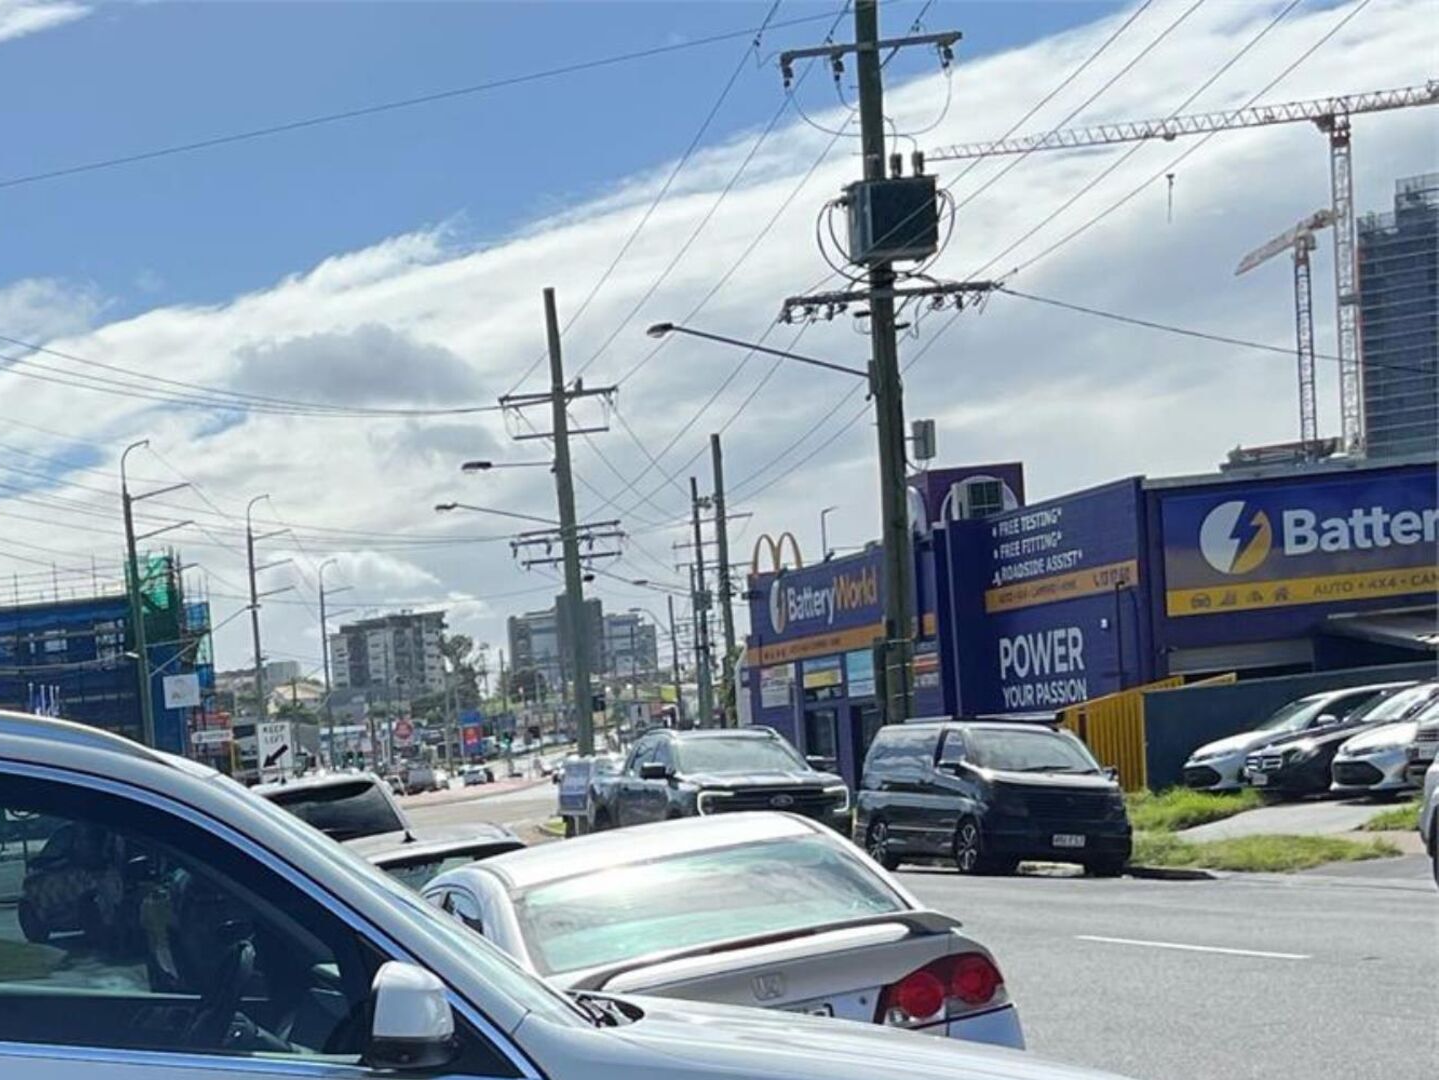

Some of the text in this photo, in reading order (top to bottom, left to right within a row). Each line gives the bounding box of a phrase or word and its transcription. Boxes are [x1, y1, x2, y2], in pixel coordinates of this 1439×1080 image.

[999, 516, 1020, 536] FREE
[1000, 541, 1021, 560] FREE
[1001, 559, 1045, 582] ROADSIDE
[1313, 580, 1353, 596] AUTO
[999, 627, 1085, 680] POWER
[1003, 683, 1035, 708] YOUR
[263, 724, 285, 733] KEEP
[264, 735, 284, 744] LEFT
